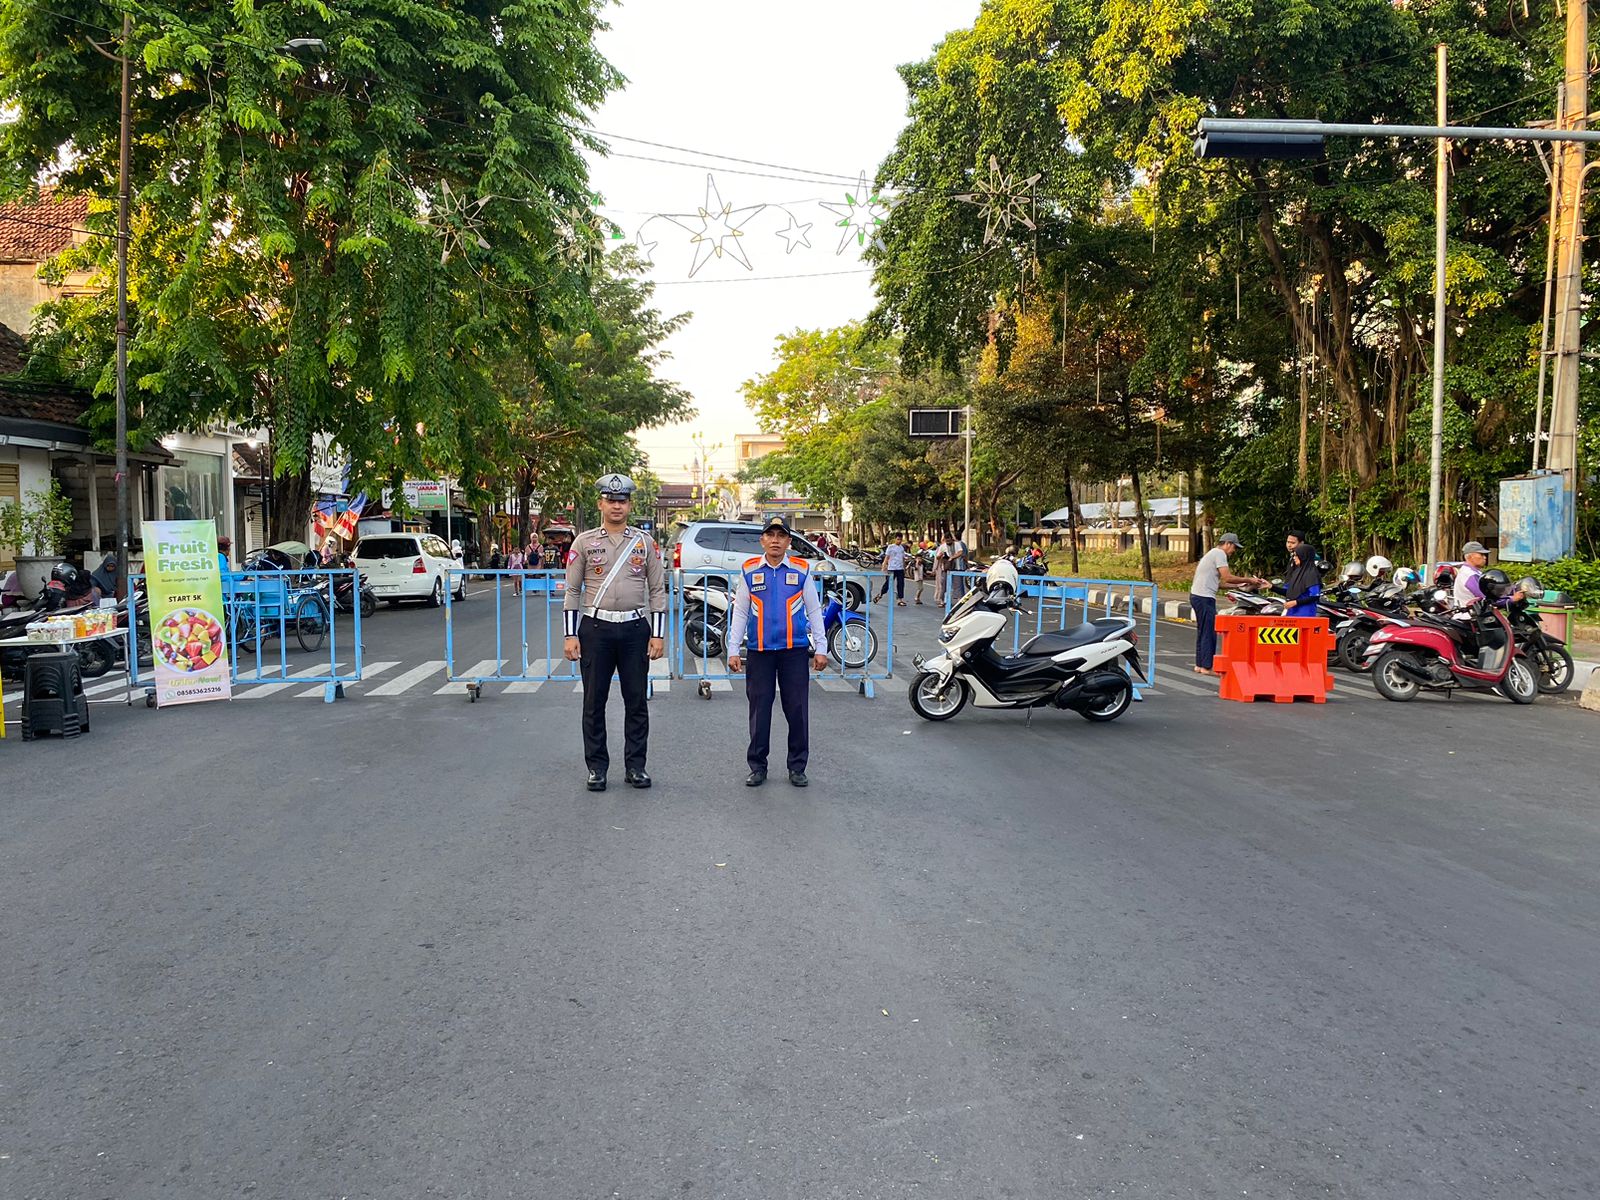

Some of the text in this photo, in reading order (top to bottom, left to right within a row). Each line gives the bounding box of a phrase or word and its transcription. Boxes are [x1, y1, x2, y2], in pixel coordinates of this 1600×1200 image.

[311, 444, 339, 469] evice
[158, 540, 207, 555] Fruit
[158, 557, 214, 572] Fresh
[545, 552, 556, 562] 87
